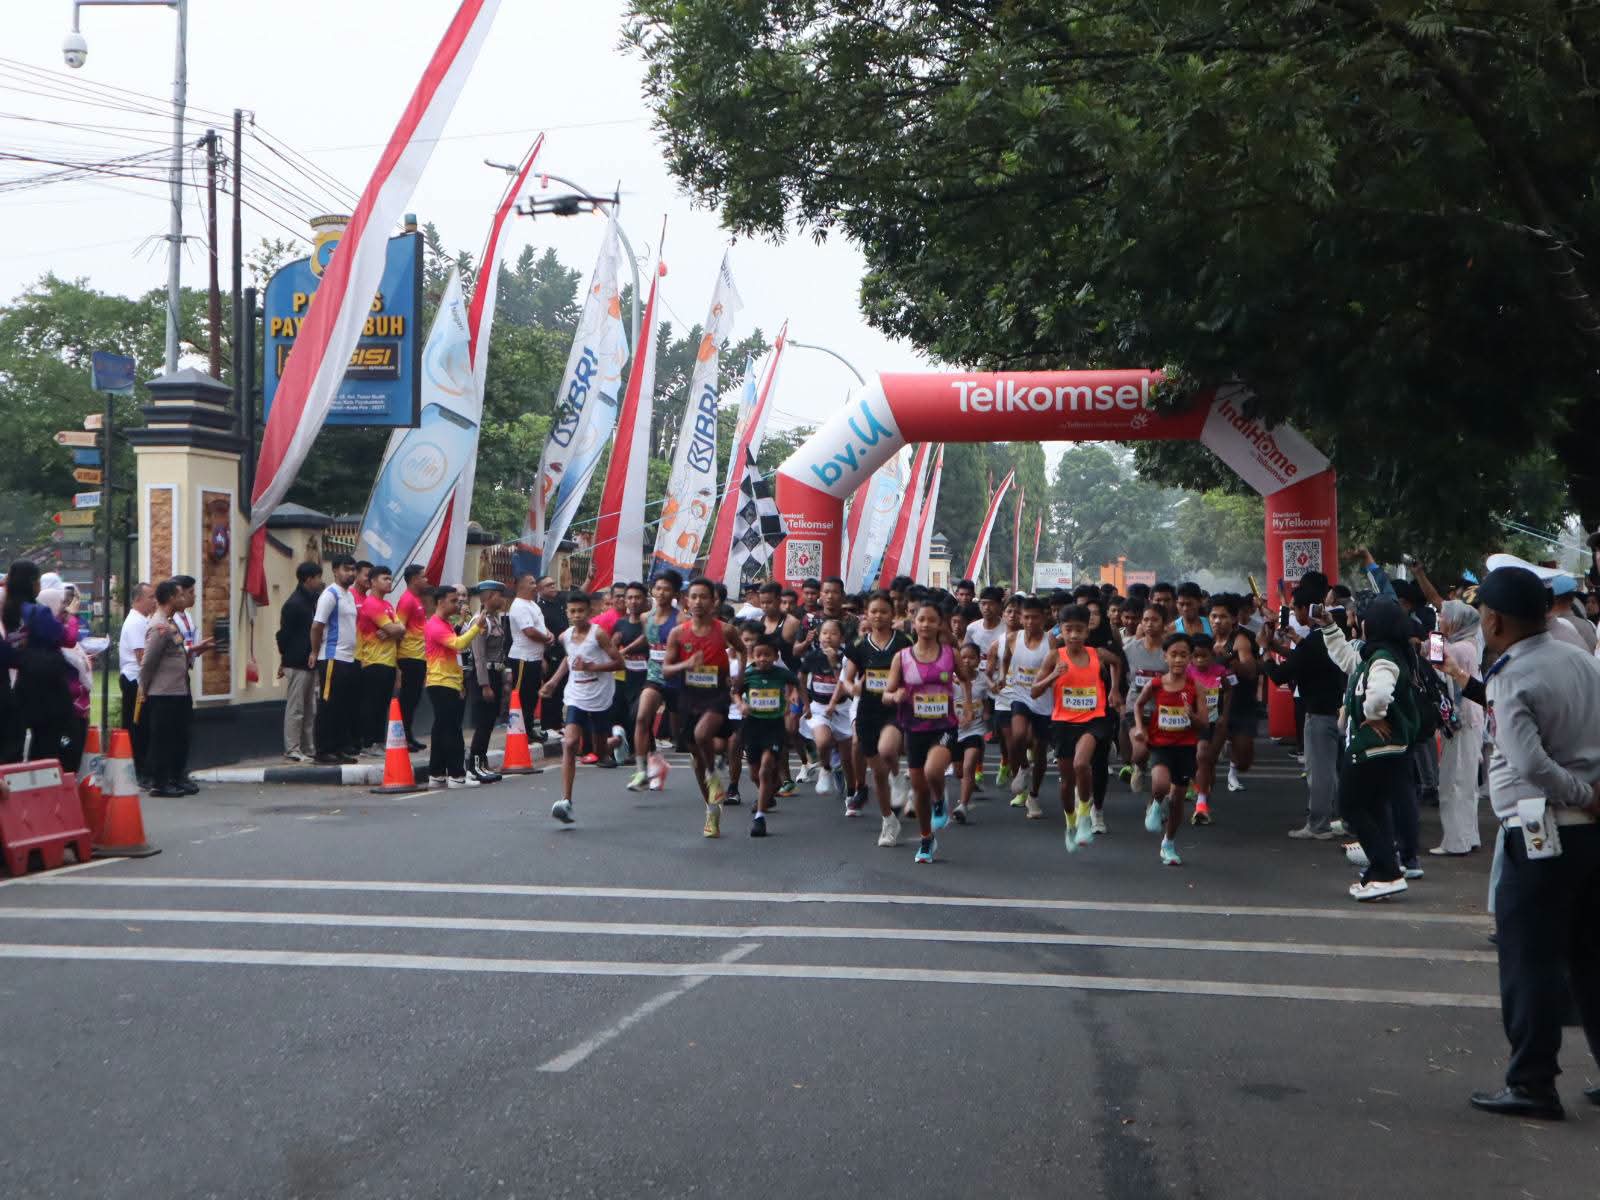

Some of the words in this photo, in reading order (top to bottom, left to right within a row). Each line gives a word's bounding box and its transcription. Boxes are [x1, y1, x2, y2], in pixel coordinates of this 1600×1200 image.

[695, 383, 719, 440] BRI
[951, 377, 1150, 413] Telkomsel
[1218, 399, 1298, 477] IndiHome
[1272, 518, 1331, 528] MyTelkomsel
[1065, 698, 1094, 706] P-26129
